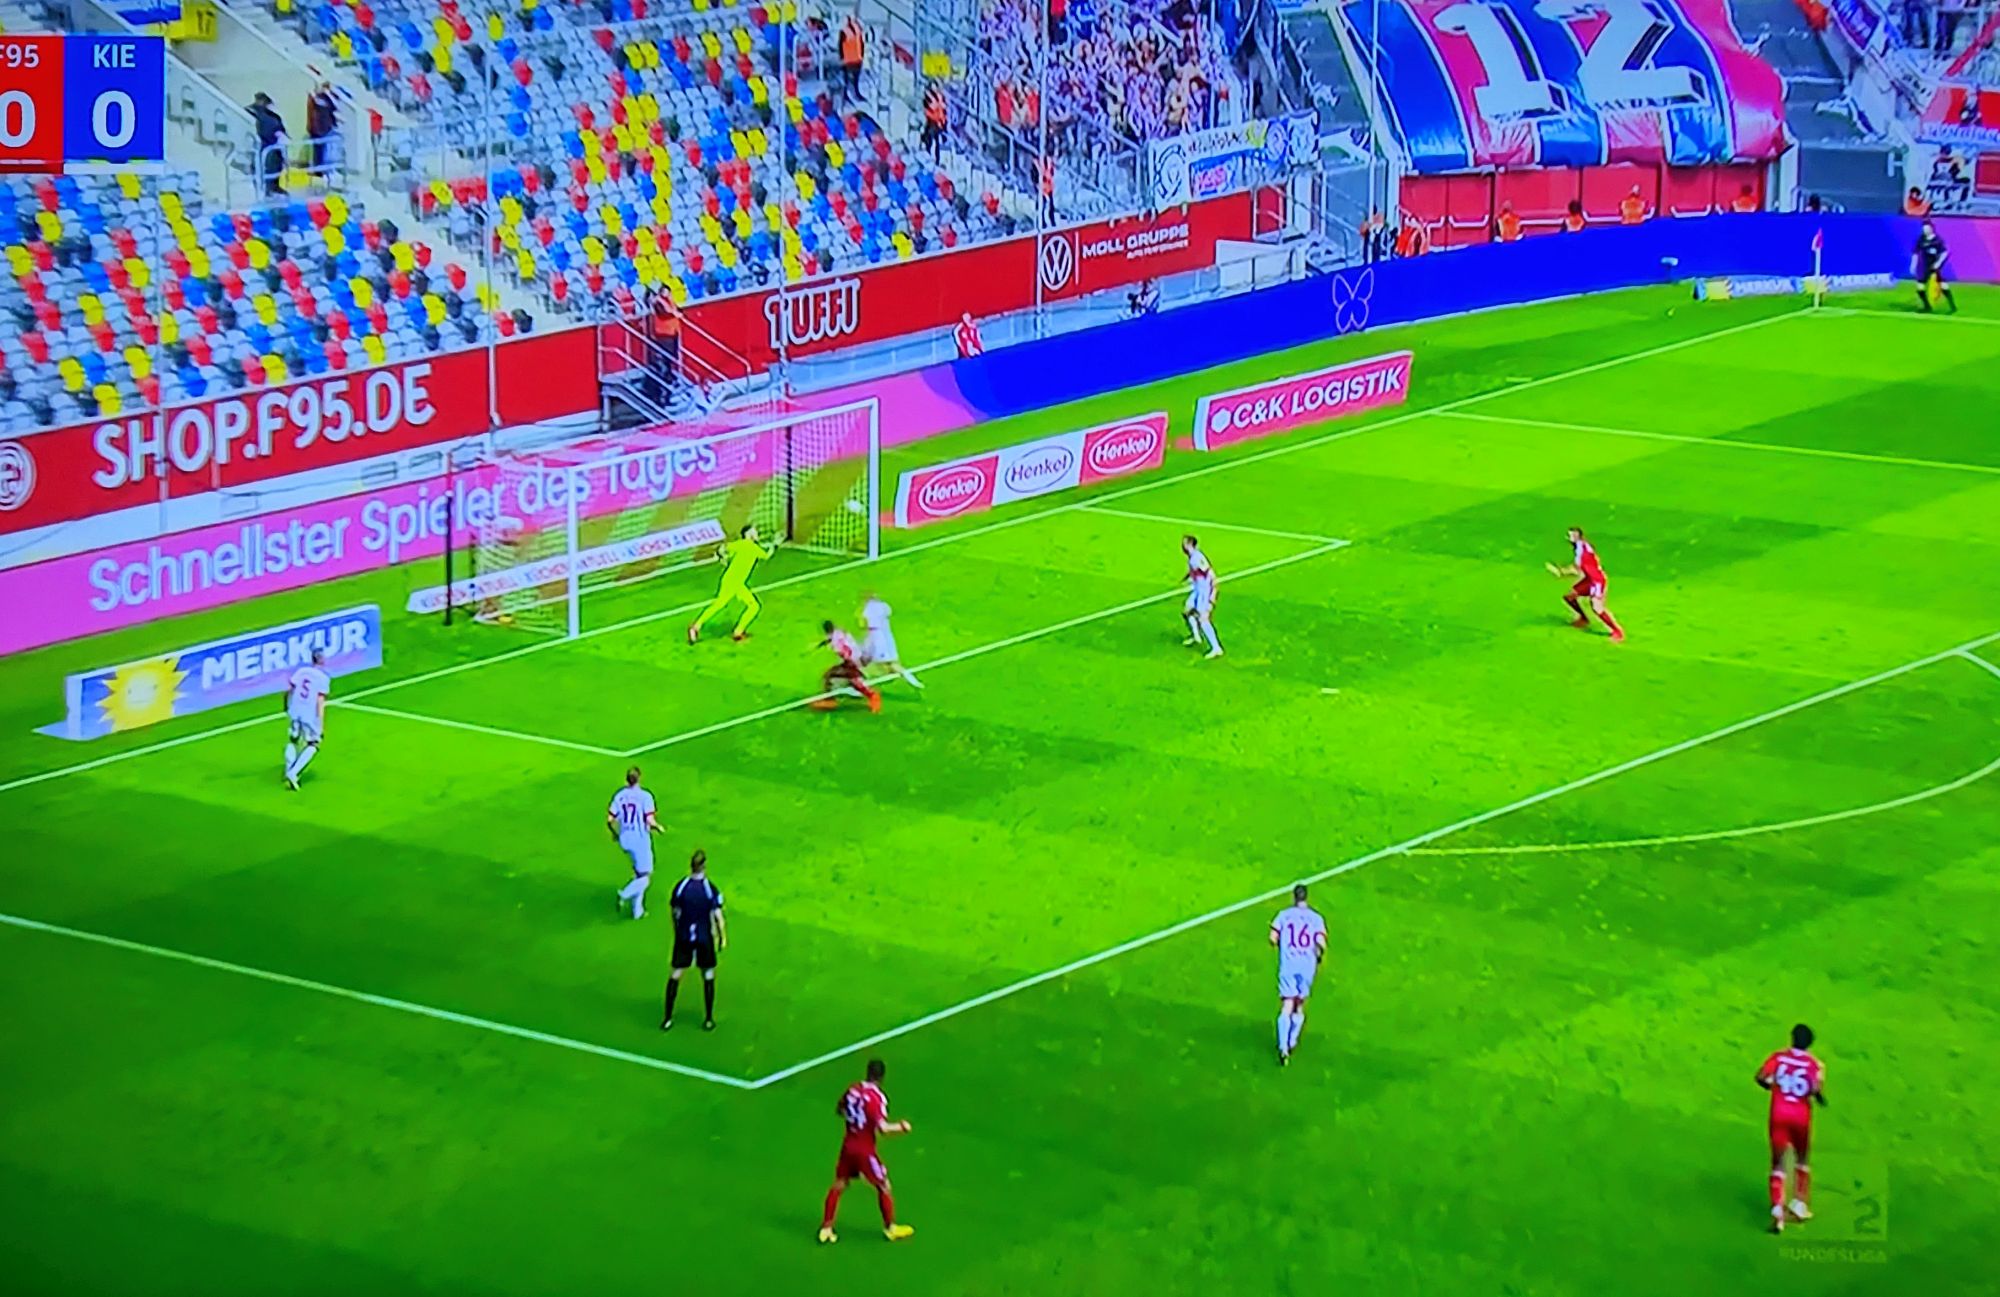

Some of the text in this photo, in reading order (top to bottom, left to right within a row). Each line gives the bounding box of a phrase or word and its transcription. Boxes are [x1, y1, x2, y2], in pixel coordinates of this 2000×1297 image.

[1082, 238, 1124, 259] MOLL
[1126, 224, 1189, 249] GRUPPE
[1233, 365, 1404, 429] C&K LOGISTIK
[92, 363, 436, 489] SHOP.F95.DE
[1096, 433, 1150, 463] Henkel
[1010, 454, 1067, 483] Henkel
[925, 474, 979, 502] Henkel
[90, 519, 349, 610] Schnellster
[362, 485, 507, 562] Spieler
[520, 463, 589, 514] des
[202, 620, 368, 690] MERKUR
[301, 679, 311, 699] 5
[622, 804, 636, 823] 17
[1287, 923, 1310, 948] 16
[1776, 1064, 1810, 1096] 46
